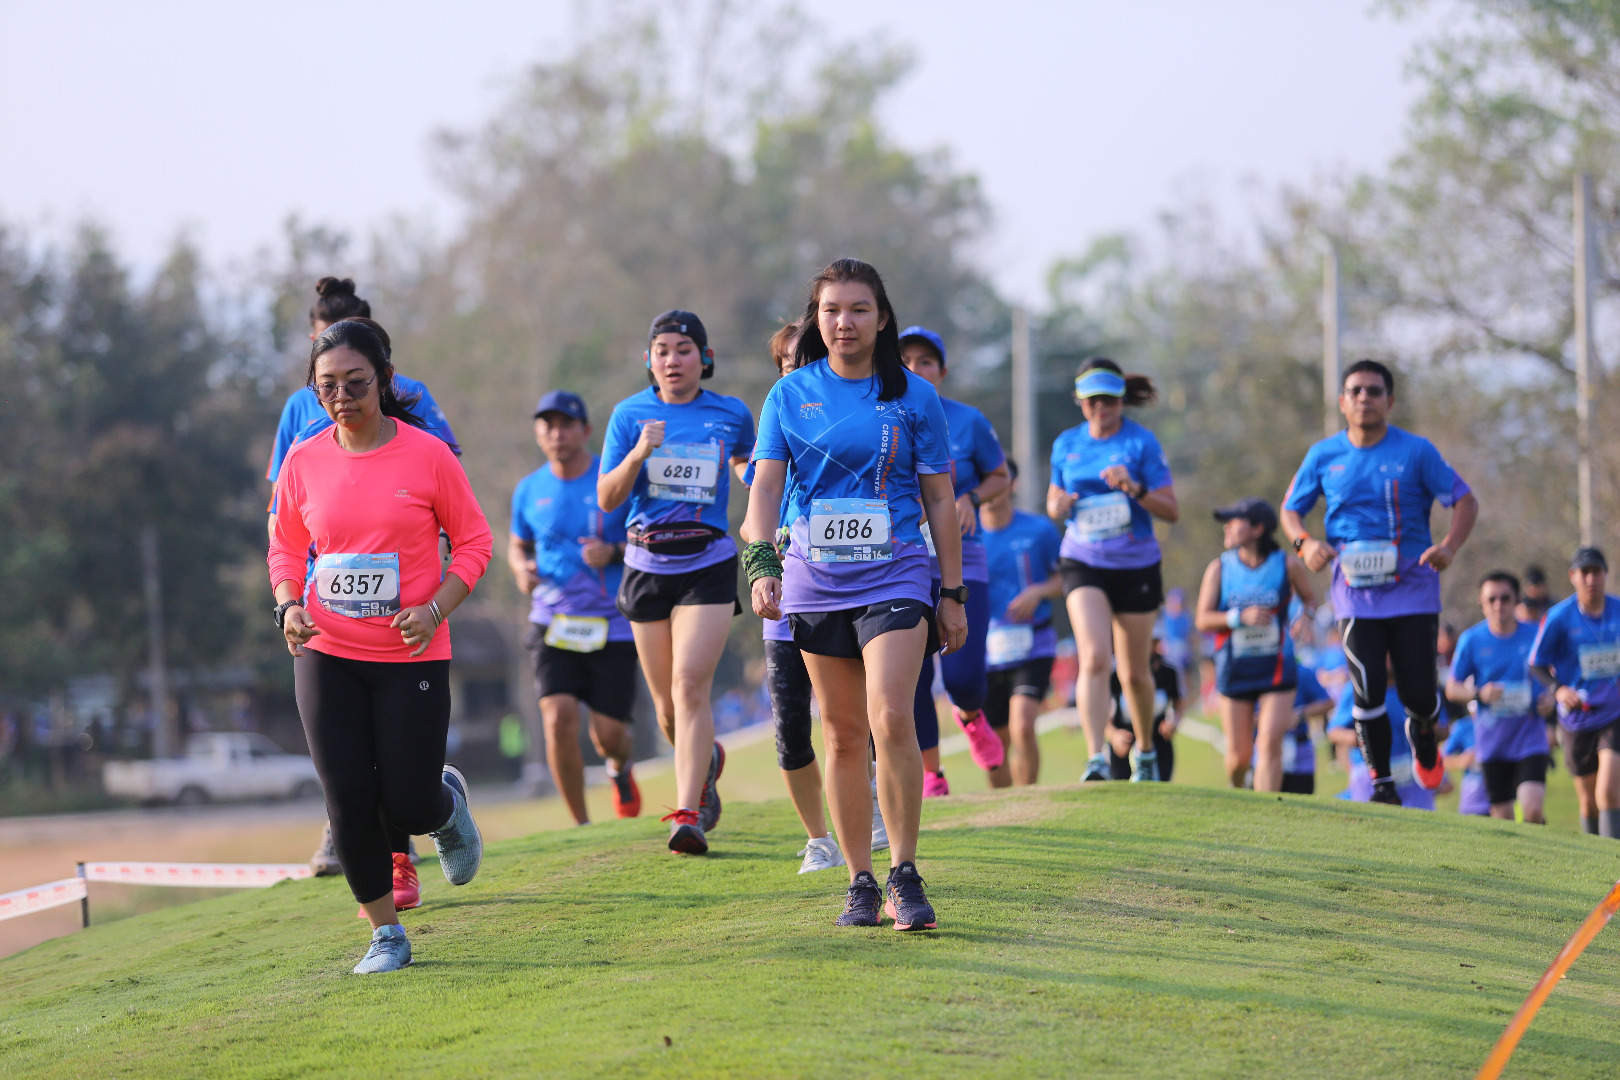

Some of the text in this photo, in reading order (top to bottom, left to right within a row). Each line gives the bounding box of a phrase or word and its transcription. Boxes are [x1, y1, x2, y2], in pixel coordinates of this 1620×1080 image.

[881, 423, 889, 453] CROSS
[887, 425, 899, 463] SINGHA
[663, 464, 701, 479] 6281
[879, 465, 891, 490] PARK
[824, 518, 873, 540] 6186
[1354, 554, 1384, 570] 6011
[330, 574, 384, 595] 6357
